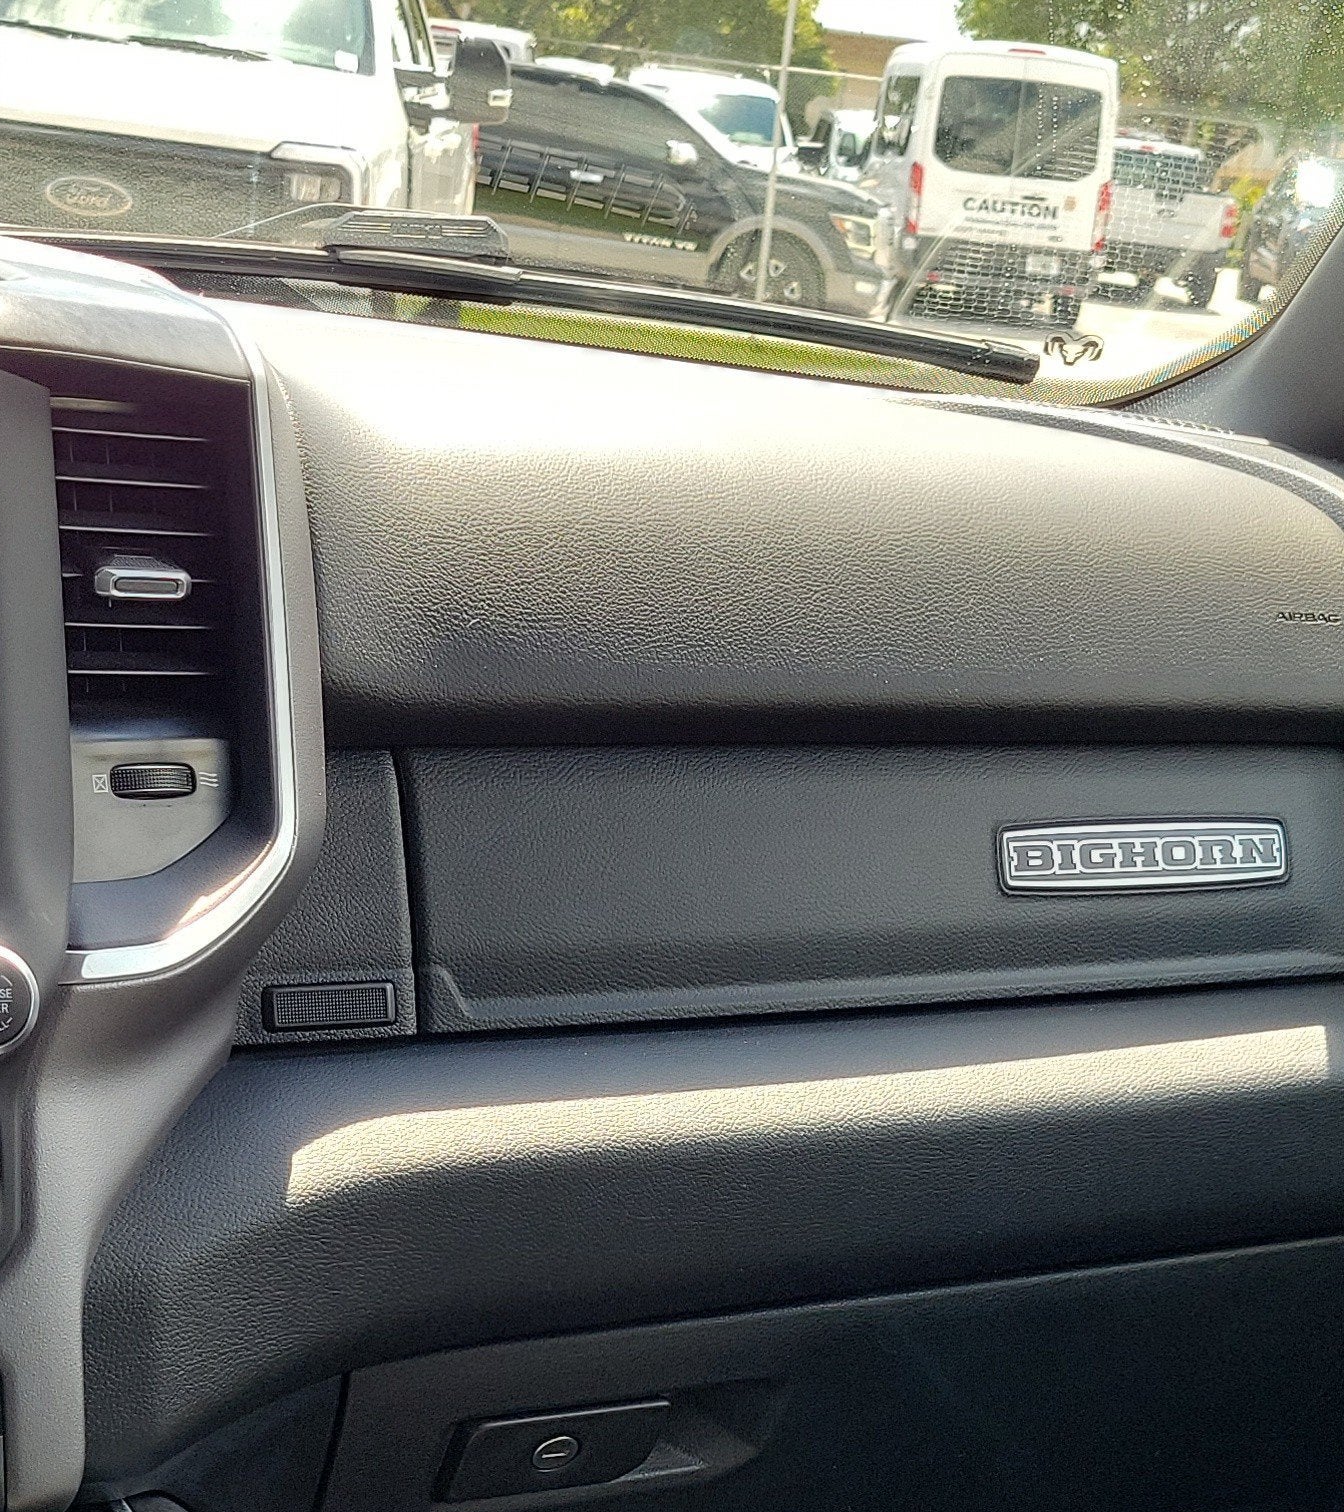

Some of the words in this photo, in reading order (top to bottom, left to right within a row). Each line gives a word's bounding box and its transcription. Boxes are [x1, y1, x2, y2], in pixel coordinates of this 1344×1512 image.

[963, 197, 1059, 220] CAUTION
[1276, 611, 1342, 623] AIRBAG
[1009, 834, 1282, 876] BIGHORN
